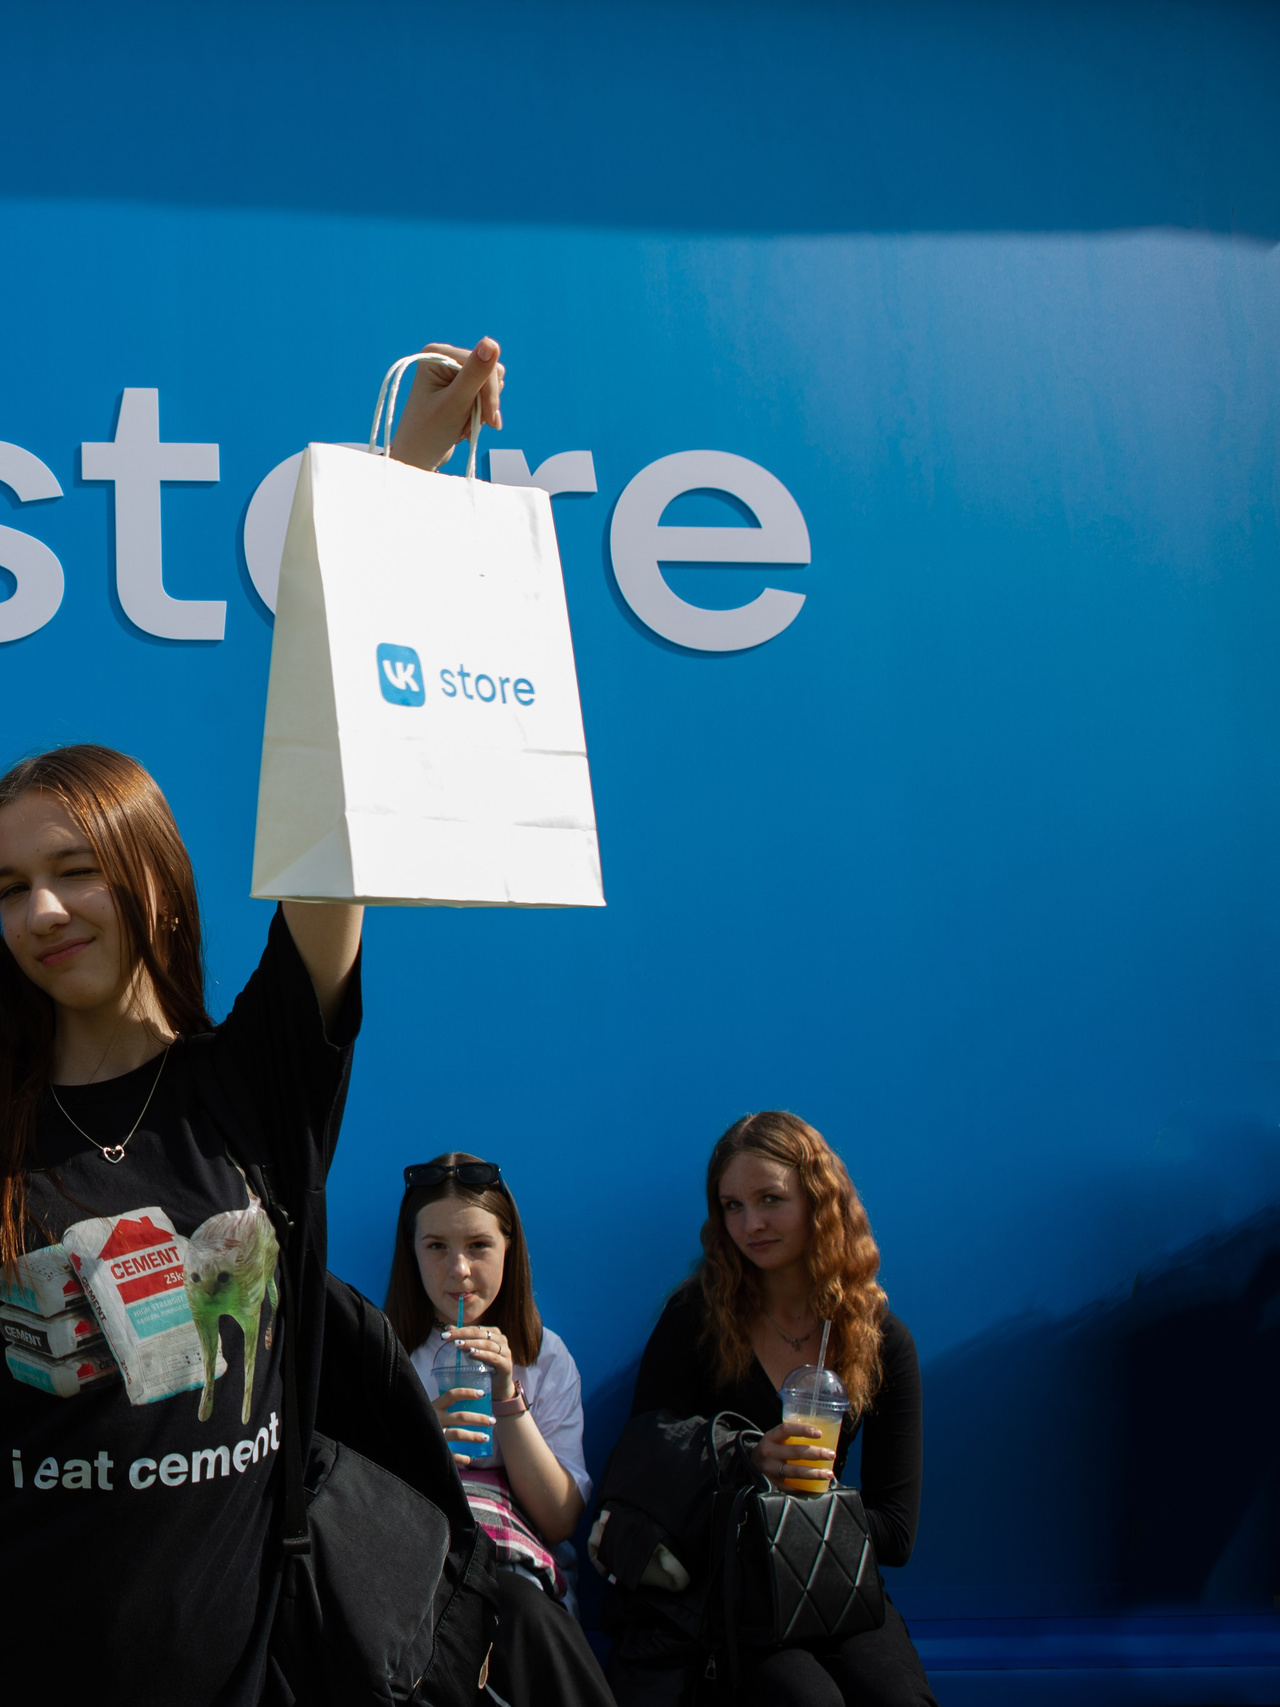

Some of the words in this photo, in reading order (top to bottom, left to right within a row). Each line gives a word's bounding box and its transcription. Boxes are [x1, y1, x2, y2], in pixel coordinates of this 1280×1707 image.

[382, 659, 420, 692] VK
[440, 663, 535, 706] store
[110, 1246, 181, 1280] CEMENT
[82, 1276, 107, 1321] CEMENT
[4, 1325, 42, 1347] CEMENT
[12, 1449, 24, 1488] i
[34, 1451, 114, 1490] eat
[129, 1411, 280, 1490] cement
